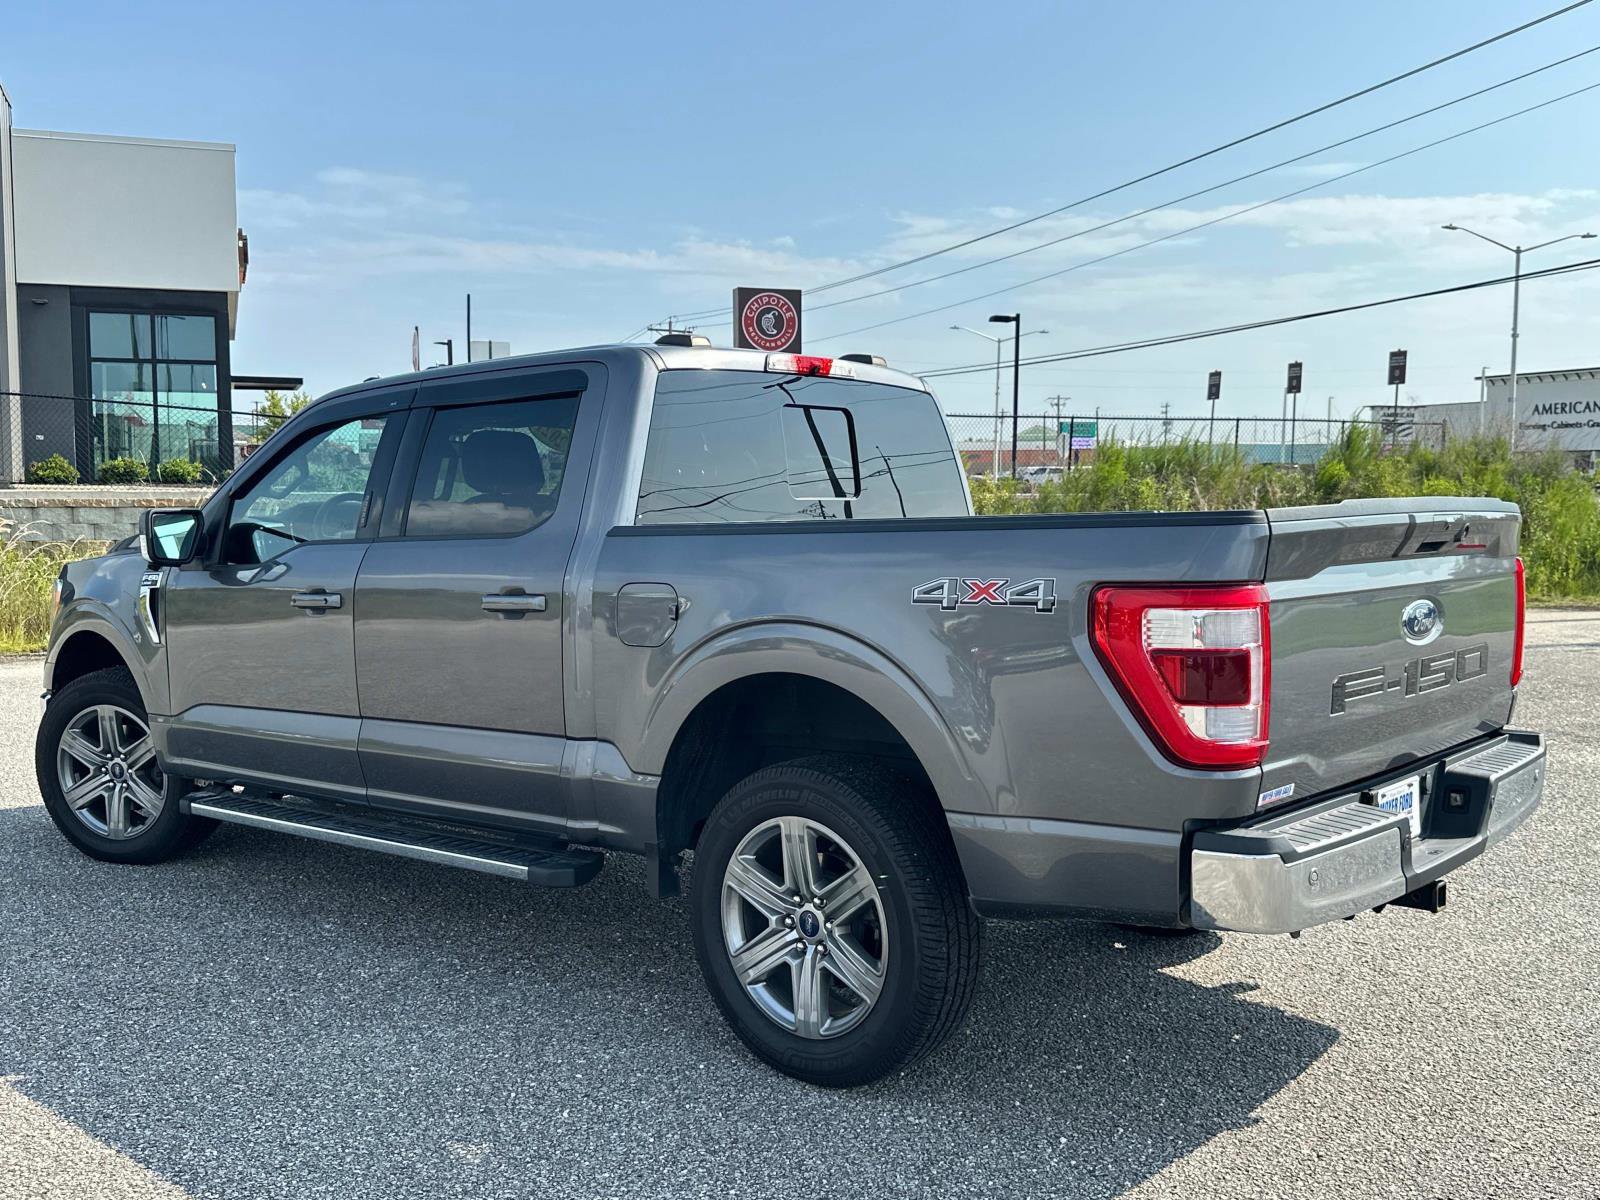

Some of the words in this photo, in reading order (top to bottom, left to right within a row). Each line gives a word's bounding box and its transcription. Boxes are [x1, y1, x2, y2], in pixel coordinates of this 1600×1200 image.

[747, 296, 794, 319] CHIPOTLE
[748, 327, 776, 347] MEXICAN
[776, 329, 793, 346] GRILL
[1532, 401, 1600, 416] AMERICAN
[1330, 642, 1488, 717] F-150
[1399, 791, 1413, 812] FORD
